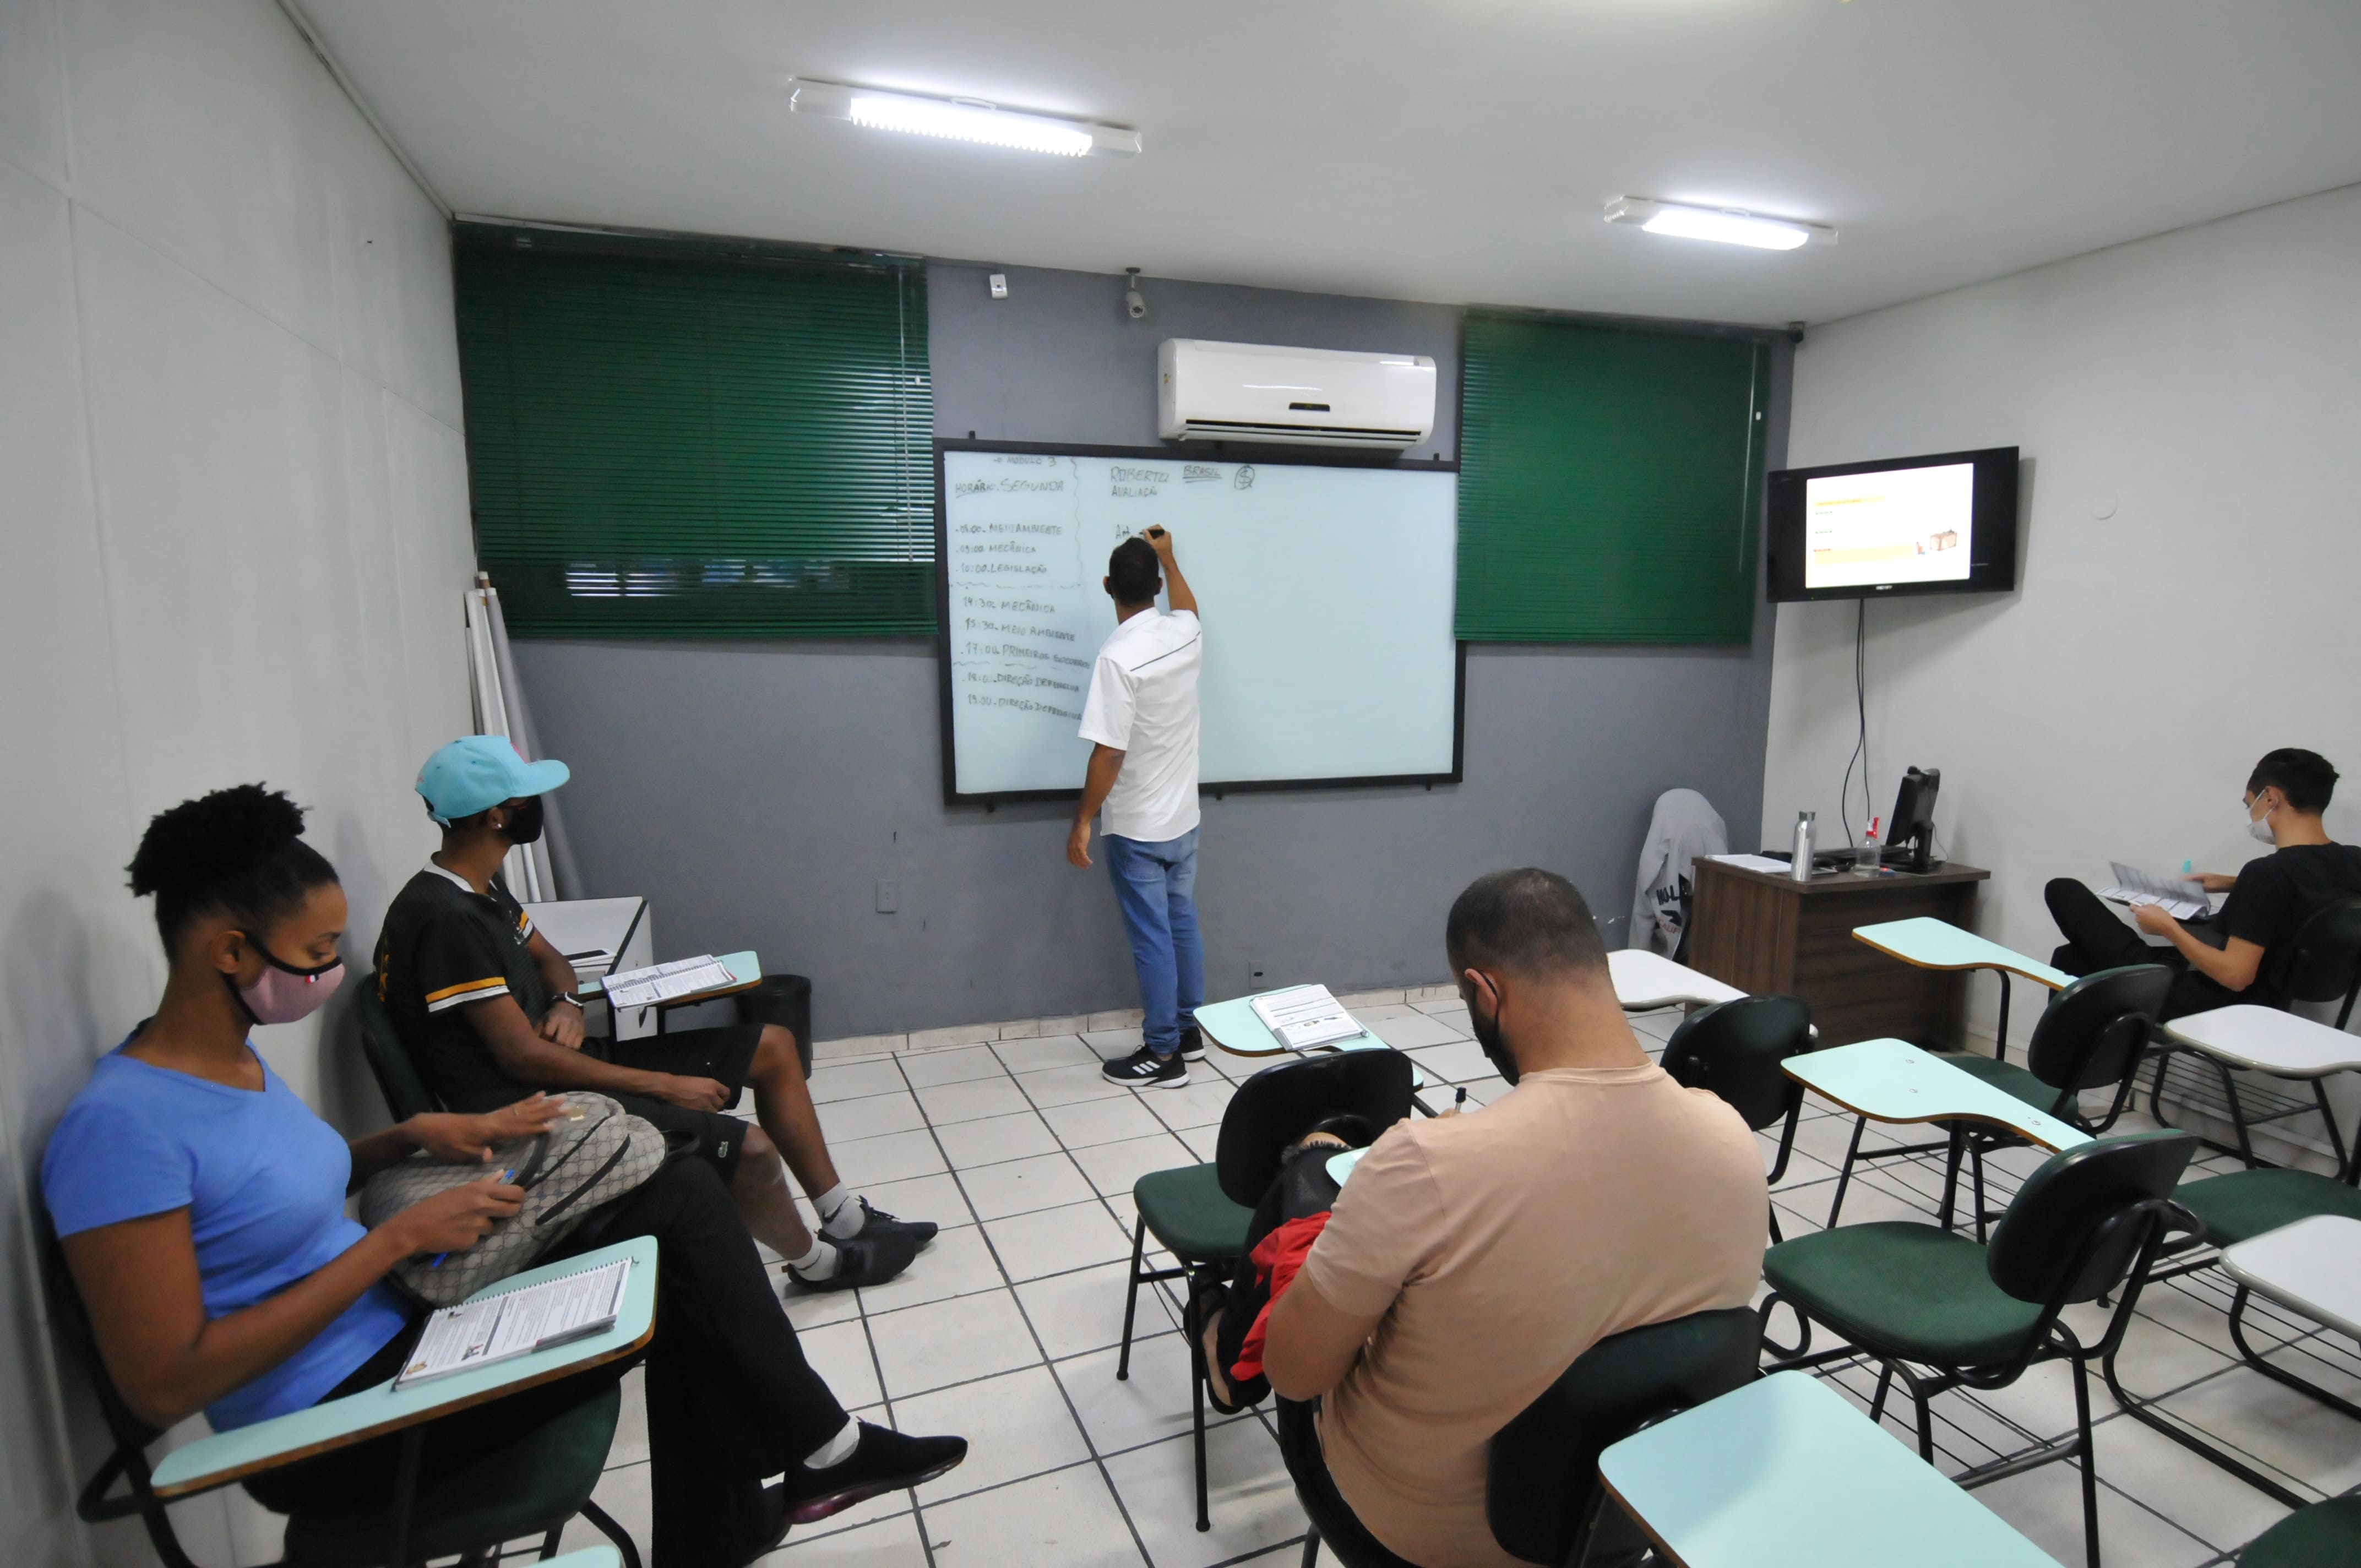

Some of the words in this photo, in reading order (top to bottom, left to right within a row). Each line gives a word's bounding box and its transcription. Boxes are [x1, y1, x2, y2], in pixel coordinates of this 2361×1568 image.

[1048, 456, 1056, 467] 3
[1183, 465, 1220, 477] BRASIL
[1000, 478, 1064, 492] SEGUNDA
[1001, 599, 1056, 613] MECÂNICA
[1001, 625, 1026, 636] MEIO
[1030, 626, 1075, 642] AMBIENTE
[1002, 644, 1050, 660] PRIMEIROS
